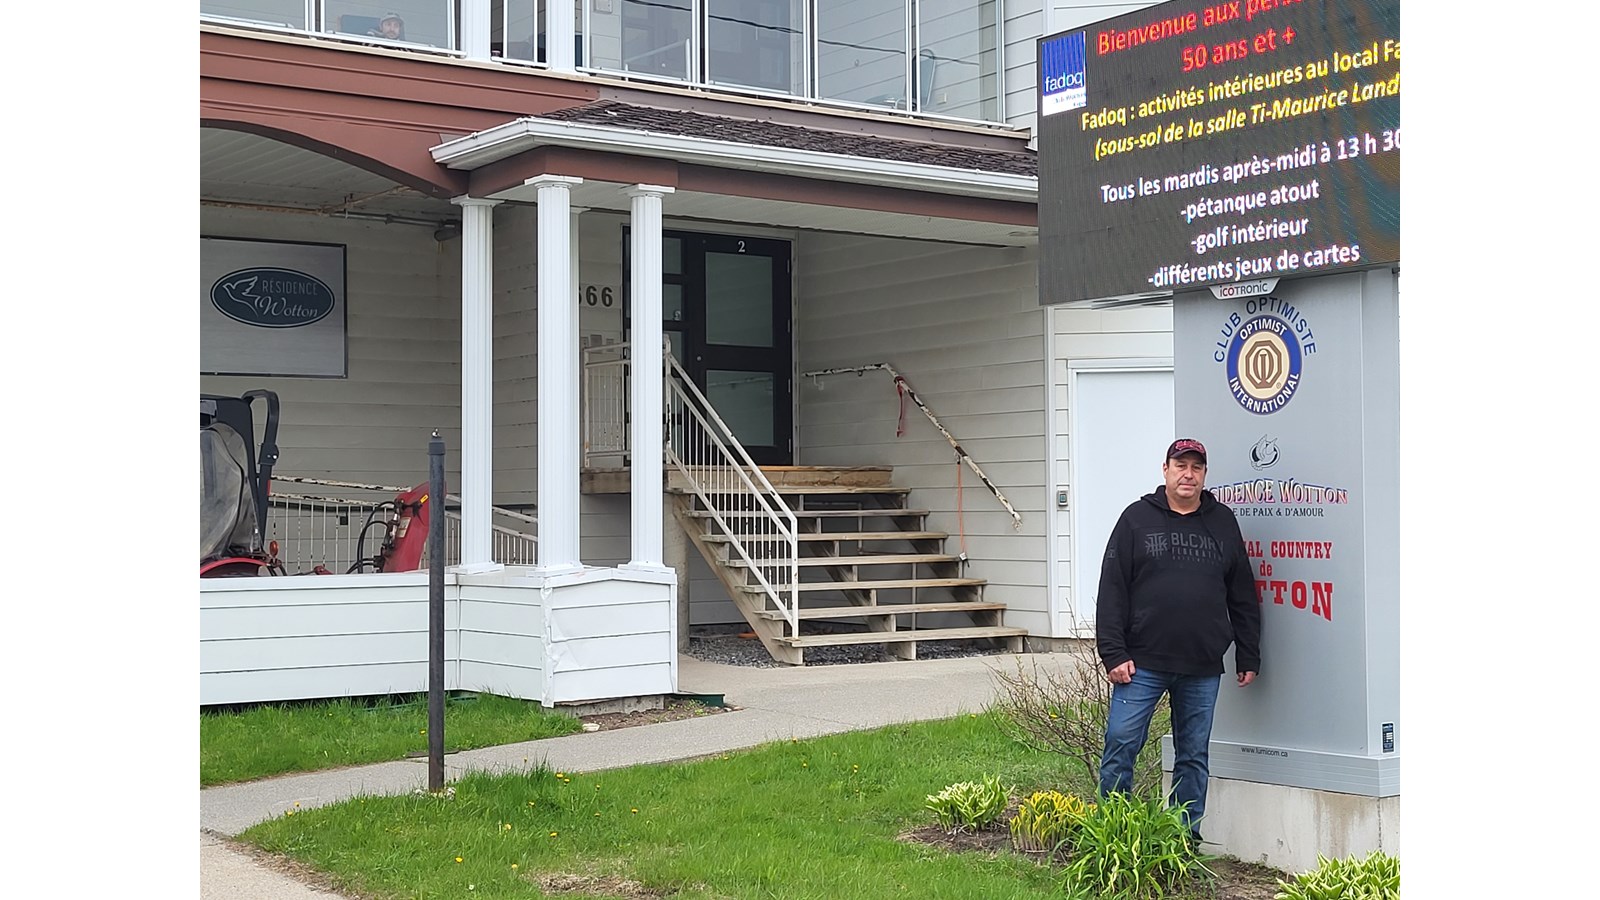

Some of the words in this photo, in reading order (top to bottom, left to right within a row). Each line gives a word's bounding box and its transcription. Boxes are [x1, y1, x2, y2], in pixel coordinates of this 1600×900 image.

[1098, 13, 1197, 55] Bienvenue
[1203, 1, 1241, 27] aux
[1182, 44, 1208, 72] 50
[1212, 40, 1248, 64] ans
[1254, 28, 1277, 54] et
[1045, 72, 1083, 92] fadoq
[1082, 107, 1126, 131] Fadoq
[1138, 86, 1205, 118] activités
[1208, 75, 1303, 102] intérieures
[1305, 60, 1329, 80] au
[1333, 41, 1379, 74] local
[1095, 124, 1162, 161] (sous-sol
[1164, 122, 1184, 143] de
[1187, 118, 1204, 138] la
[1206, 107, 1247, 135] salle
[1250, 89, 1349, 124] Ti-Maurice
[1351, 72, 1400, 103] Land
[1100, 184, 1136, 203] Tous
[1138, 177, 1161, 197] les
[1164, 164, 1219, 192] mardis
[1222, 144, 1317, 184] après-midi
[1320, 141, 1331, 163] à
[1337, 137, 1360, 160] 13
[1364, 132, 1377, 155] h
[1181, 191, 1267, 224] -pétanque
[1270, 179, 1320, 206] atout
[737, 240, 747, 253] 2
[1191, 225, 1229, 255] -golf
[1231, 218, 1309, 245] intérieur
[1148, 262, 1234, 287] -différents
[1235, 257, 1272, 281] jeux
[1276, 249, 1300, 271] de
[1303, 244, 1360, 268] cartes
[262, 279, 319, 296] RÉSIDENCE
[579, 285, 613, 307] 66
[259, 296, 319, 317] Wotton
[1214, 311, 1242, 363] CLUB
[1246, 297, 1316, 356] OPTIMISTE
[1240, 318, 1287, 340] OPTIMIST
[1229, 372, 1299, 413] INTERNATIONAL
[1209, 478, 1275, 504] SIDENCE
[1278, 477, 1348, 505] WOTTON
[1240, 507, 1250, 517] DE
[1253, 507, 1273, 517] PAIX
[1276, 507, 1282, 517] &
[1285, 507, 1324, 517] D'AMOUR
[1260, 560, 1273, 577] de
[1271, 541, 1333, 559] COUNTRY
[1254, 580, 1333, 622] TTON
